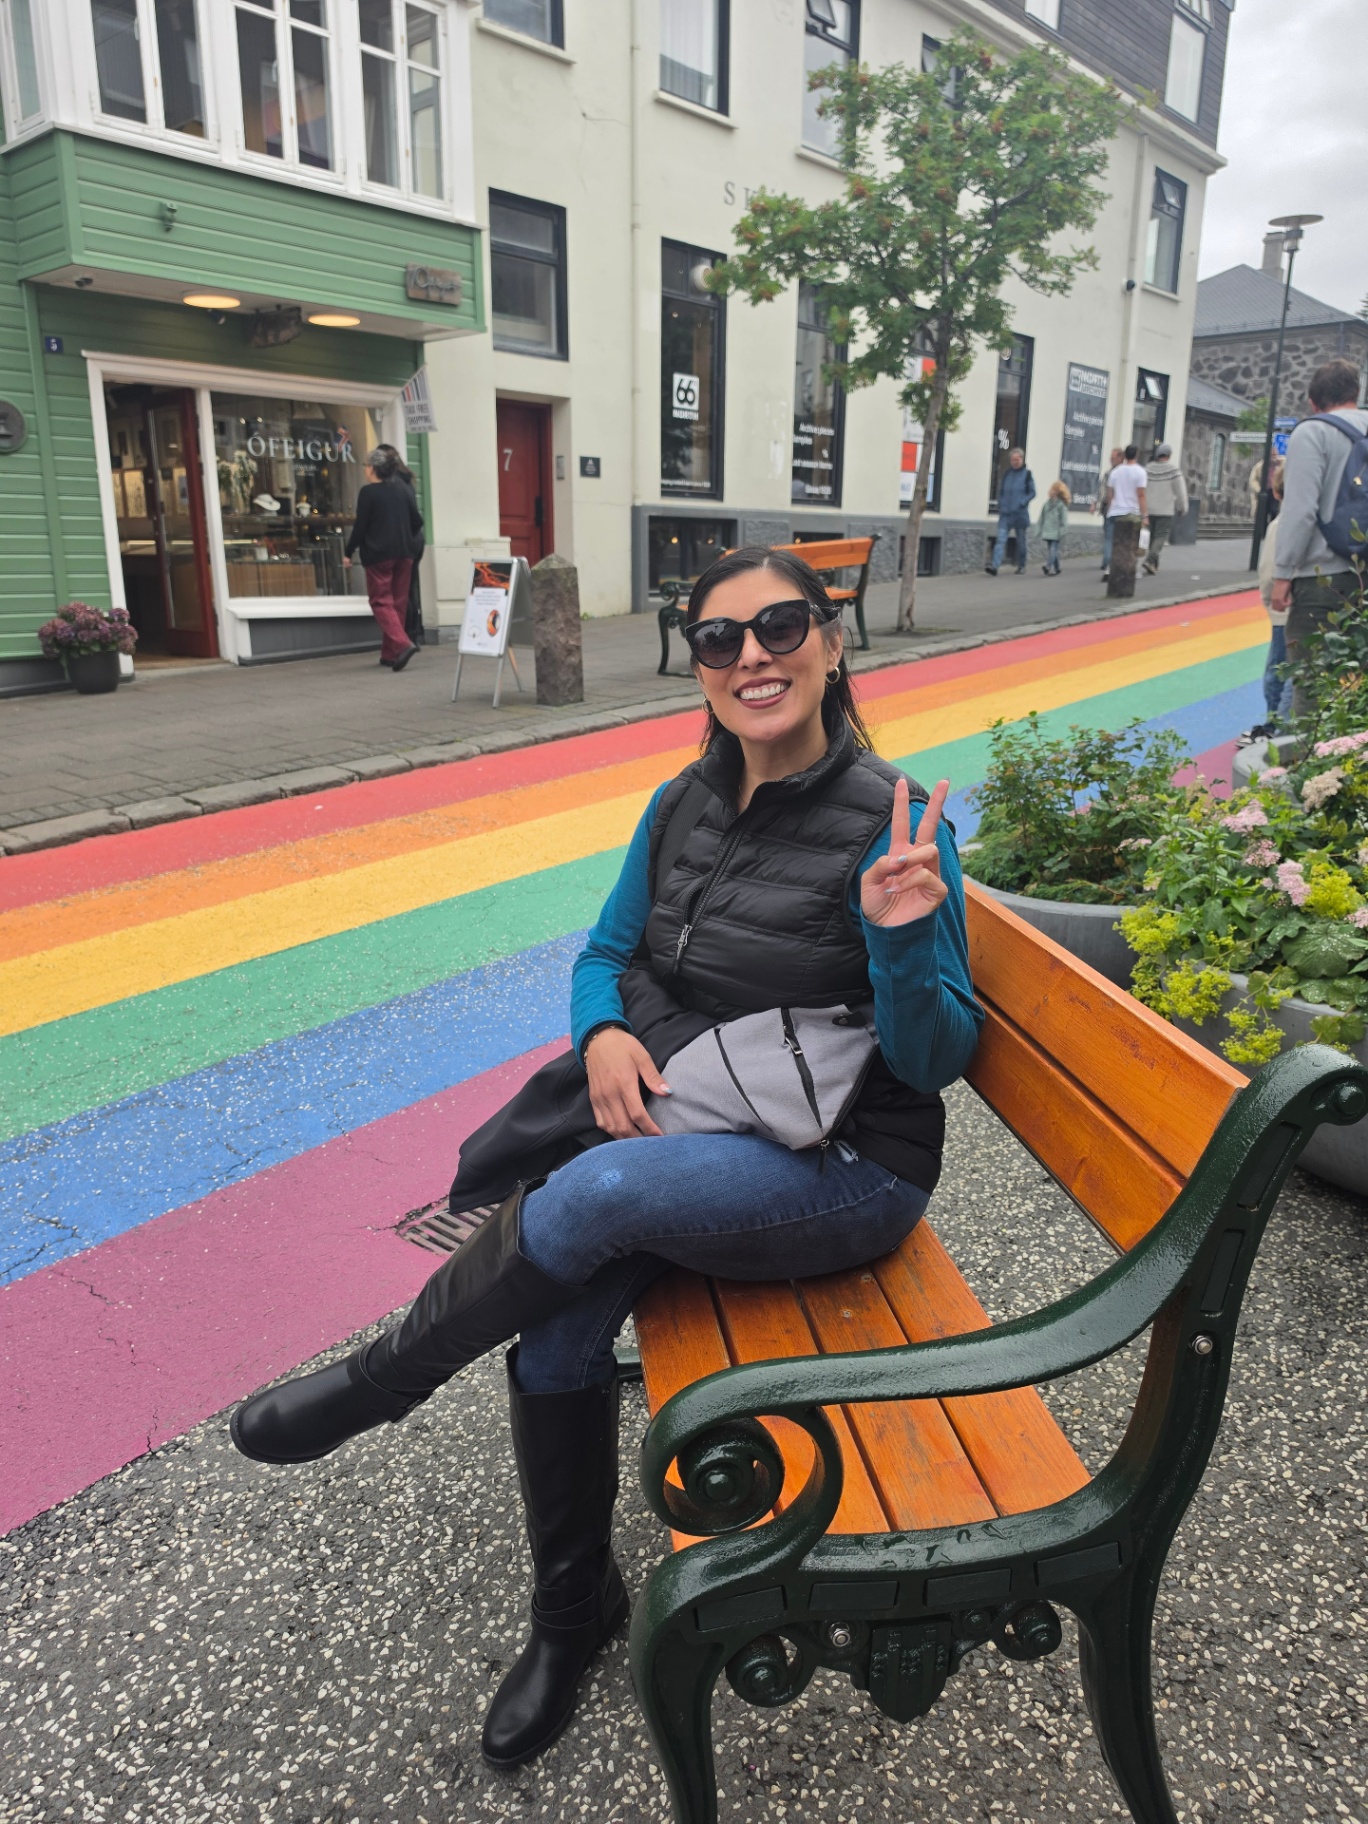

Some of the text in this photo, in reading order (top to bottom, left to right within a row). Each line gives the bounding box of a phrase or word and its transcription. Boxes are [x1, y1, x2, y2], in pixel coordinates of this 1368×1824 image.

[246, 431, 356, 463] ÓFEIGUR
[997, 429, 1010, 450] %
[503, 448, 513, 471] 7
